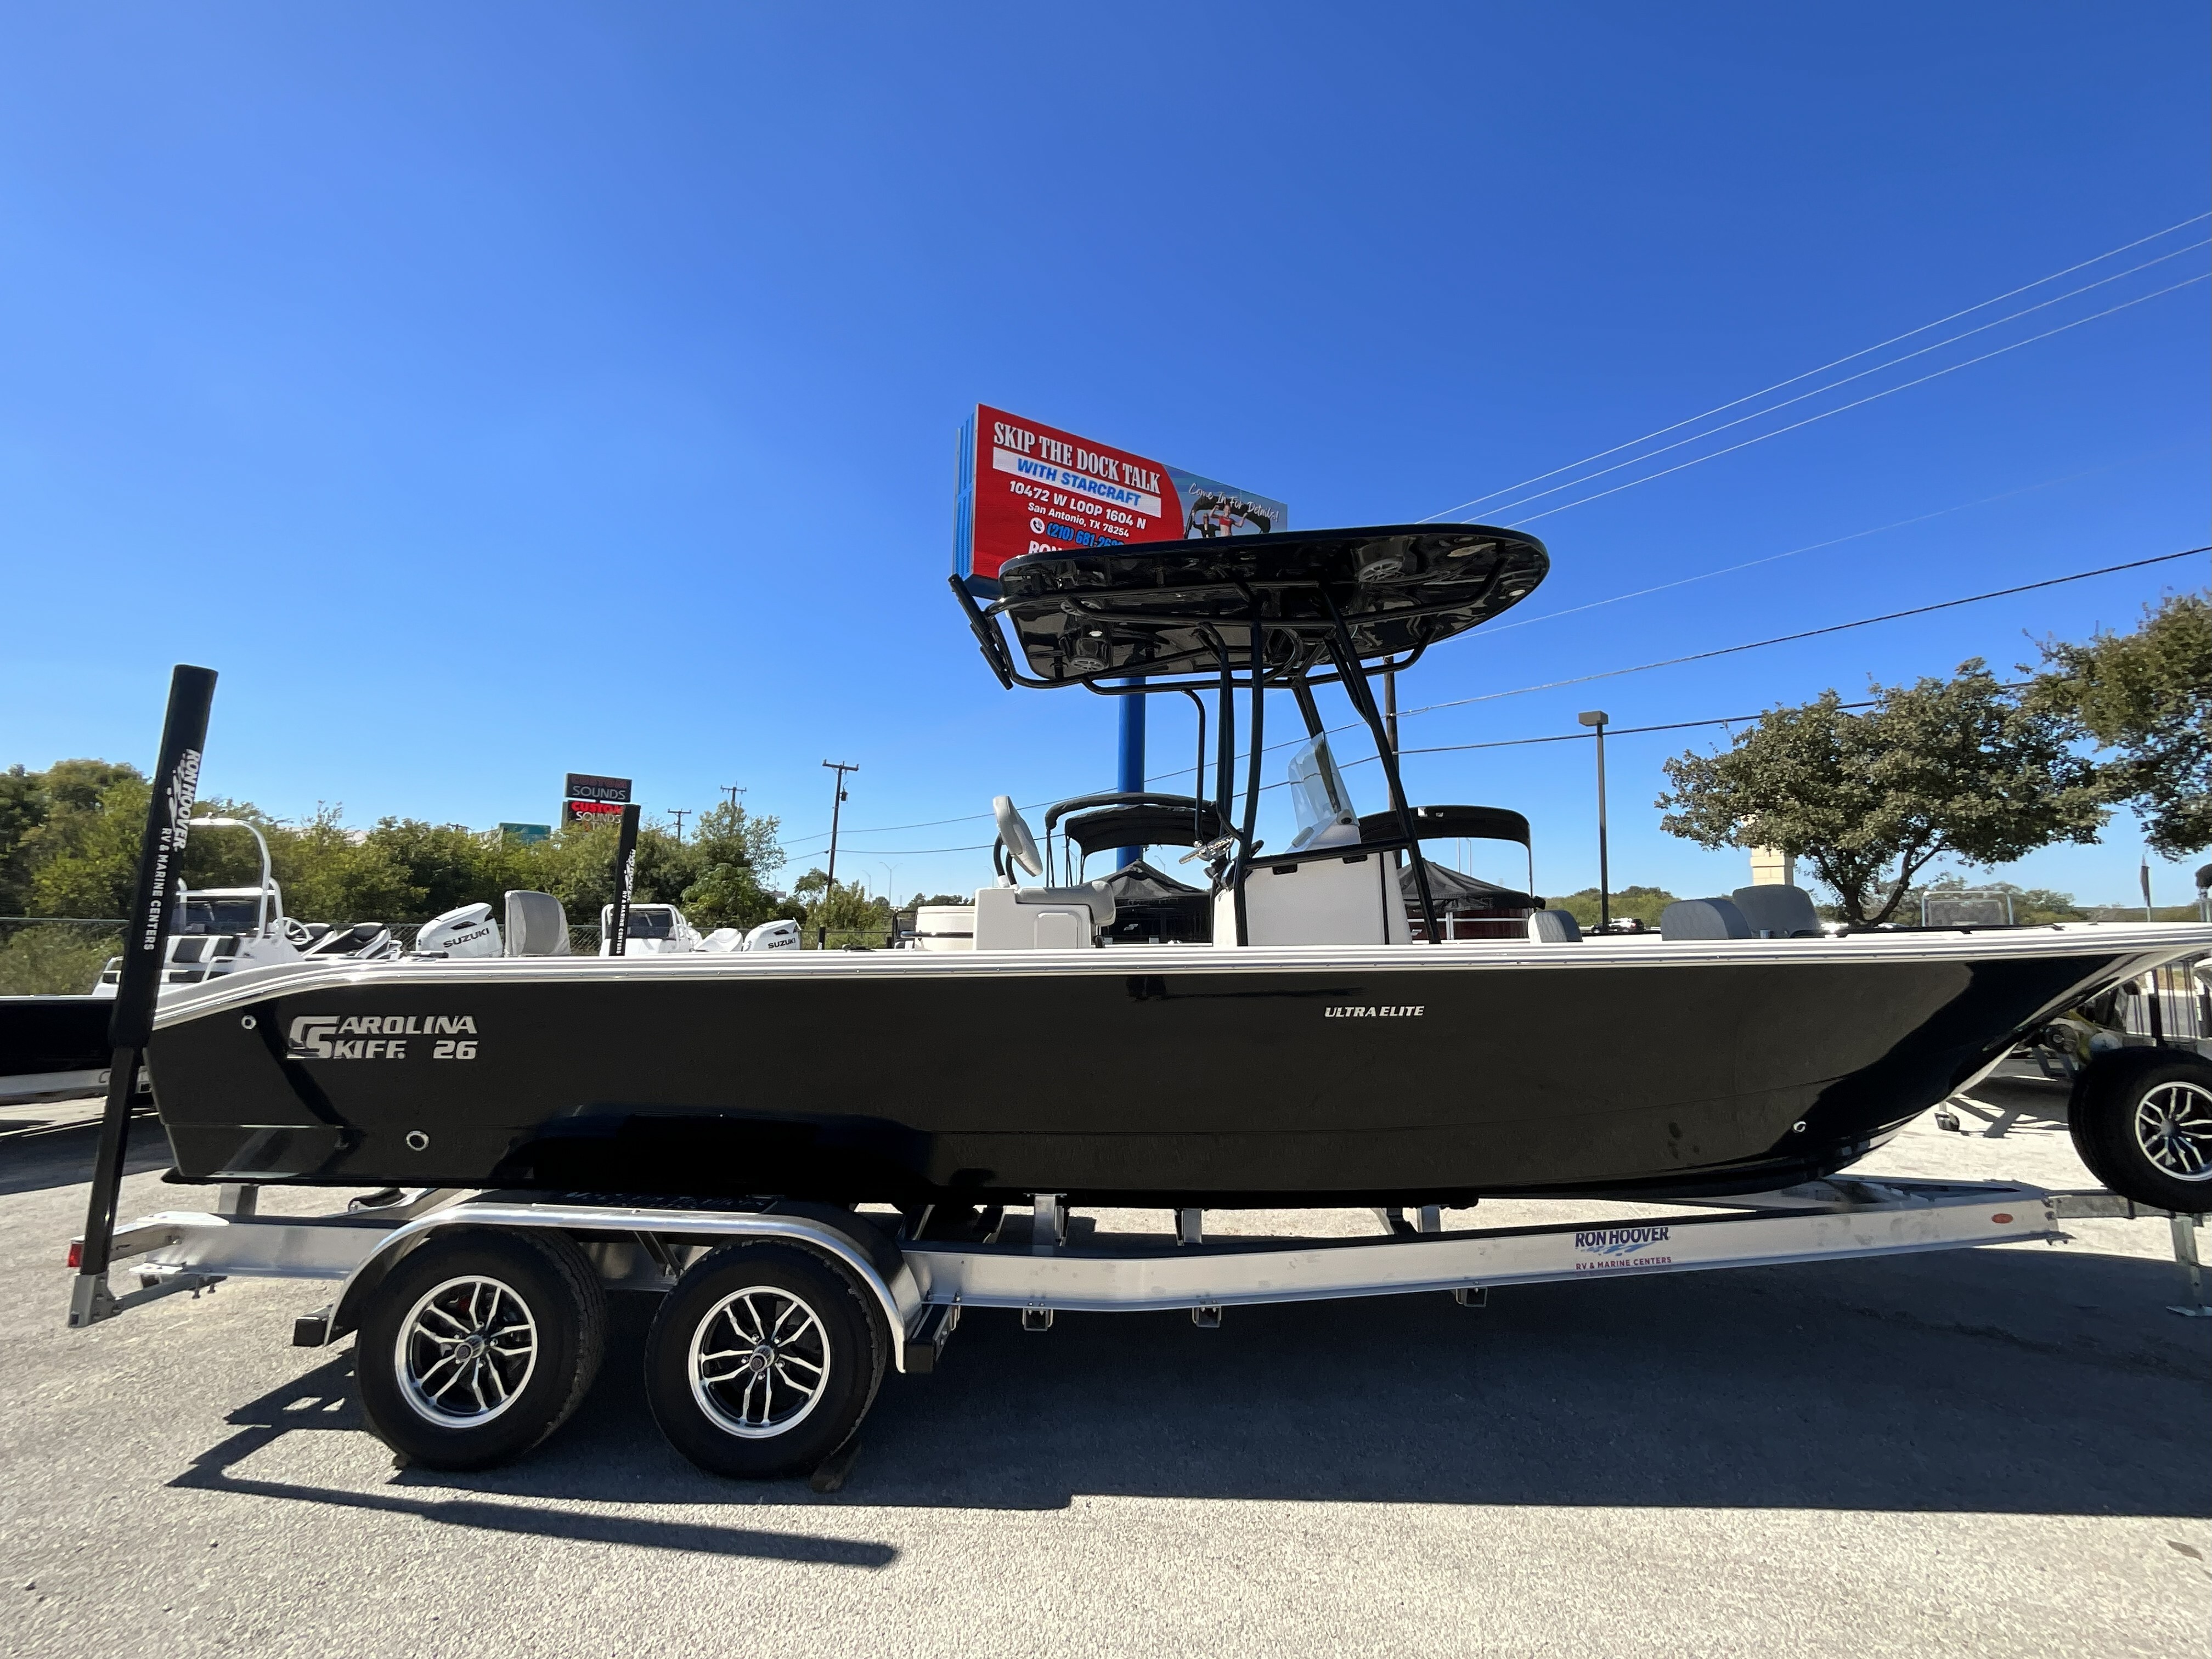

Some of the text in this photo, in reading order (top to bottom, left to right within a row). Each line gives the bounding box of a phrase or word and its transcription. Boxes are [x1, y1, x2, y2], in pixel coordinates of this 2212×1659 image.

[994, 421, 1161, 494] SKIP THE DOCK TALK
[1018, 458, 1142, 506] WITH STARCRAFT
[1009, 480, 1147, 530] 10472 W LOOP 1604 N
[1188, 482, 1279, 522] Come In For Details!
[1028, 502, 1130, 538] San Antonio, TX 78254
[1047, 522, 1125, 548] (210) 681-26
[571, 775, 628, 789] CUSTOM
[172, 748, 201, 850] RON HOOVER
[572, 786, 626, 800] SOUNDS
[571, 801, 624, 815] CUSTOM
[575, 811, 621, 823] SOUNDS
[160, 827, 172, 843] RV
[152, 854, 169, 897] MARINE
[143, 900, 162, 951] CENTERS
[443, 927, 490, 948] SUZUKI
[768, 938, 796, 949] SUZUKI
[1324, 1005, 1425, 1018] ULTRA ELITE
[289, 1015, 478, 1049] CAROLINA
[433, 1040, 479, 1059] 26
[1575, 1227, 1669, 1248] RON HOOVER
[1576, 1262, 1587, 1271] RV
[1598, 1260, 1631, 1269] MARINE
[1633, 1256, 1672, 1266] CENTERS
